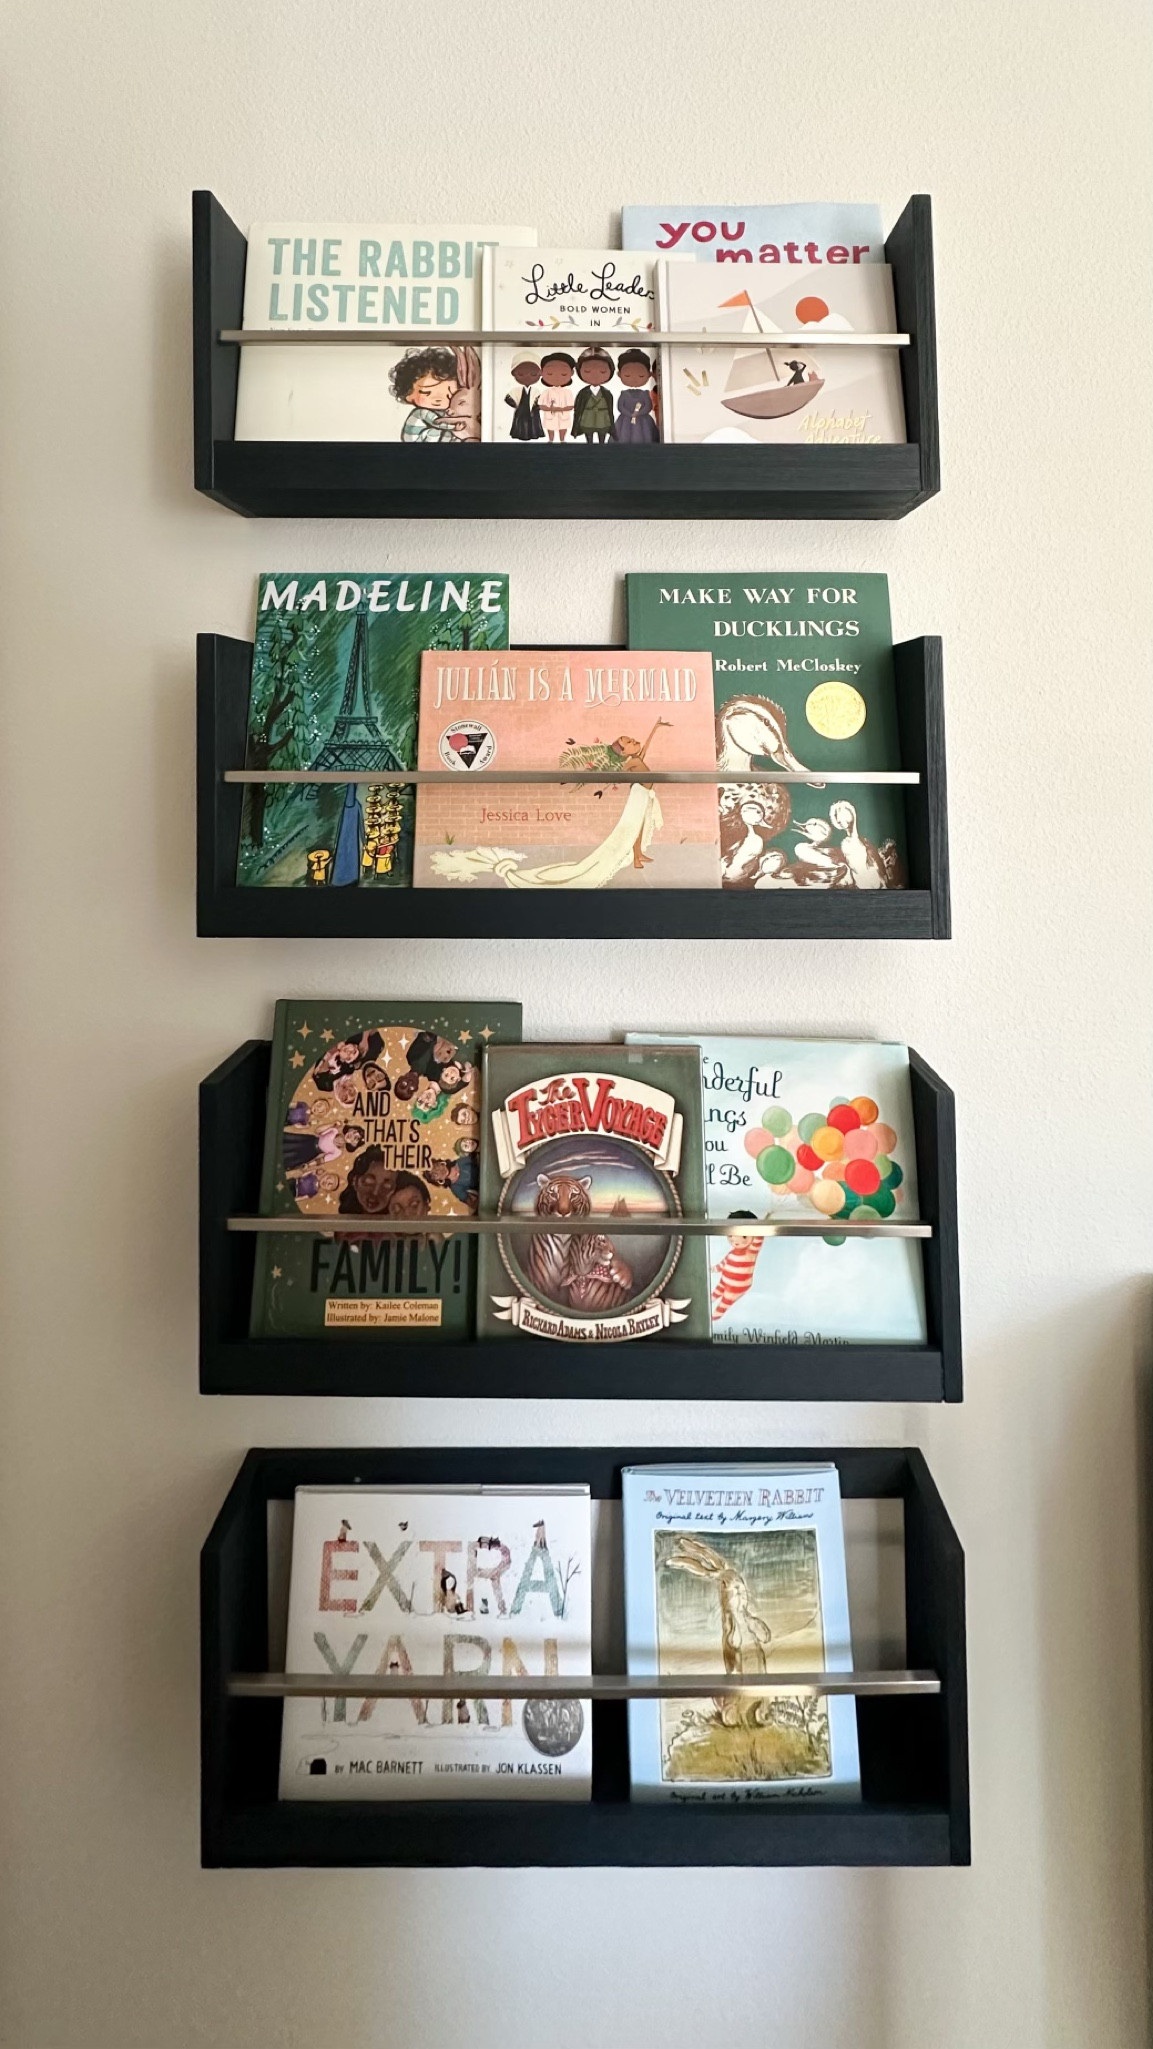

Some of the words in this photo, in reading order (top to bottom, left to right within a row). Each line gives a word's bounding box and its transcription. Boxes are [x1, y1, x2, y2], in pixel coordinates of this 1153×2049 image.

[655, 220, 746, 249] you
[268, 238, 342, 276] THE
[359, 240, 500, 278] RABBI
[715, 242, 870, 264] matter
[521, 263, 588, 304] Little
[268, 283, 459, 325] LISTENED
[560, 305, 587, 313] BOLD
[592, 306, 631, 314] WOMEN
[590, 319, 601, 327] IN
[798, 409, 872, 432] Alphabet
[261, 579, 504, 613] MADELINE
[659, 588, 732, 604] MAKE
[742, 588, 795, 604] WAY
[806, 587, 858, 604] FOR
[713, 620, 860, 637] DUCKLINGS
[714, 659, 768, 672] Robert
[776, 658, 862, 675] McCloskey
[434, 659, 517, 710] JULIÁN
[529, 667, 550, 702] IS
[559, 667, 573, 702] A
[583, 667, 697, 708] MERMAID
[480, 808, 529, 824] Jessica
[536, 808, 572, 821] Love
[539, 1077, 576, 1105] The
[352, 1091, 391, 1117] AND
[364, 1118, 421, 1143] THAT'S
[382, 1145, 433, 1170] THEIR
[705, 1140, 728, 1152] ou
[720, 1163, 752, 1186] Be
[309, 1238, 461, 1295] FAMILY!
[328, 1301, 358, 1310] Written
[375, 1301, 401, 1310] Kailee
[403, 1301, 439, 1310] Coleman
[327, 1313, 367, 1322] Illustrated
[384, 1313, 407, 1322] Jamie
[409, 1313, 440, 1322] Malone
[713, 1327, 738, 1344] mily
[664, 1488, 754, 1506] VELVETEEN
[758, 1487, 825, 1508] RABBIT
[656, 1511, 692, 1524] Original
[695, 1512, 713, 1521] text
[717, 1512, 727, 1525] by
[318, 1540, 565, 1618] EXTRA
[313, 1631, 559, 1727] YARN
[334, 1764, 344, 1774] BY
[349, 1760, 373, 1775] MAC
[376, 1760, 424, 1775] BARNETT
[434, 1763, 480, 1773] ILLUSTRATED
[481, 1764, 491, 1773] BY
[495, 1762, 514, 1774] JON
[517, 1762, 562, 1776] KLASSEN
